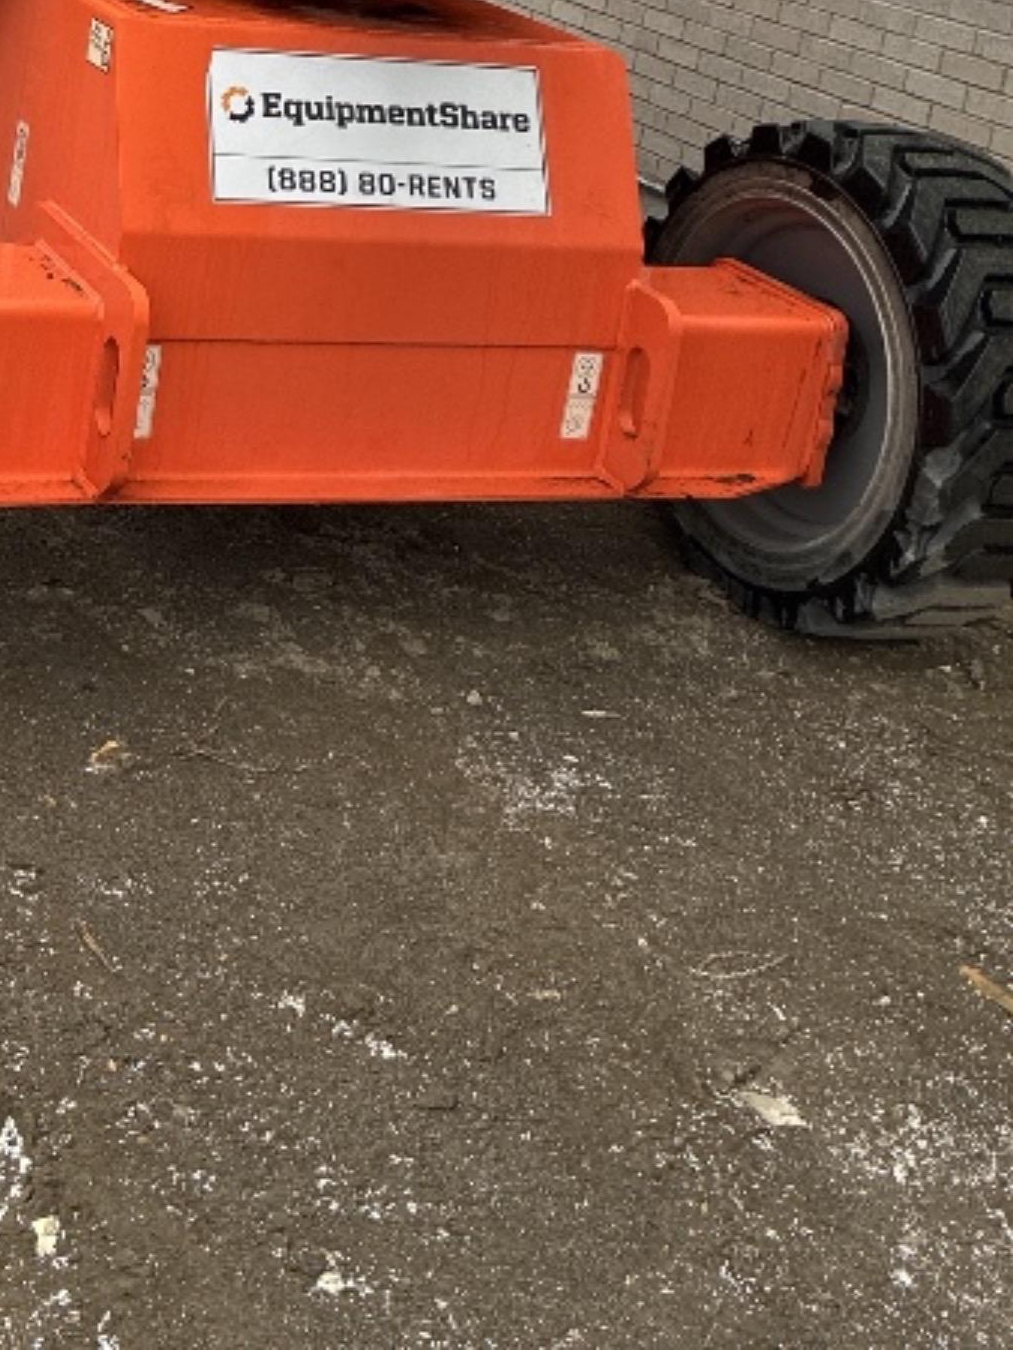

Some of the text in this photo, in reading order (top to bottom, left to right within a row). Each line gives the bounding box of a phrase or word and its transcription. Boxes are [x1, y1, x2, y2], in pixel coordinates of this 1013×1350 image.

[261, 91, 531, 134] EquipmentShare
[267, 165, 497, 201] (888) 80-RENTS
